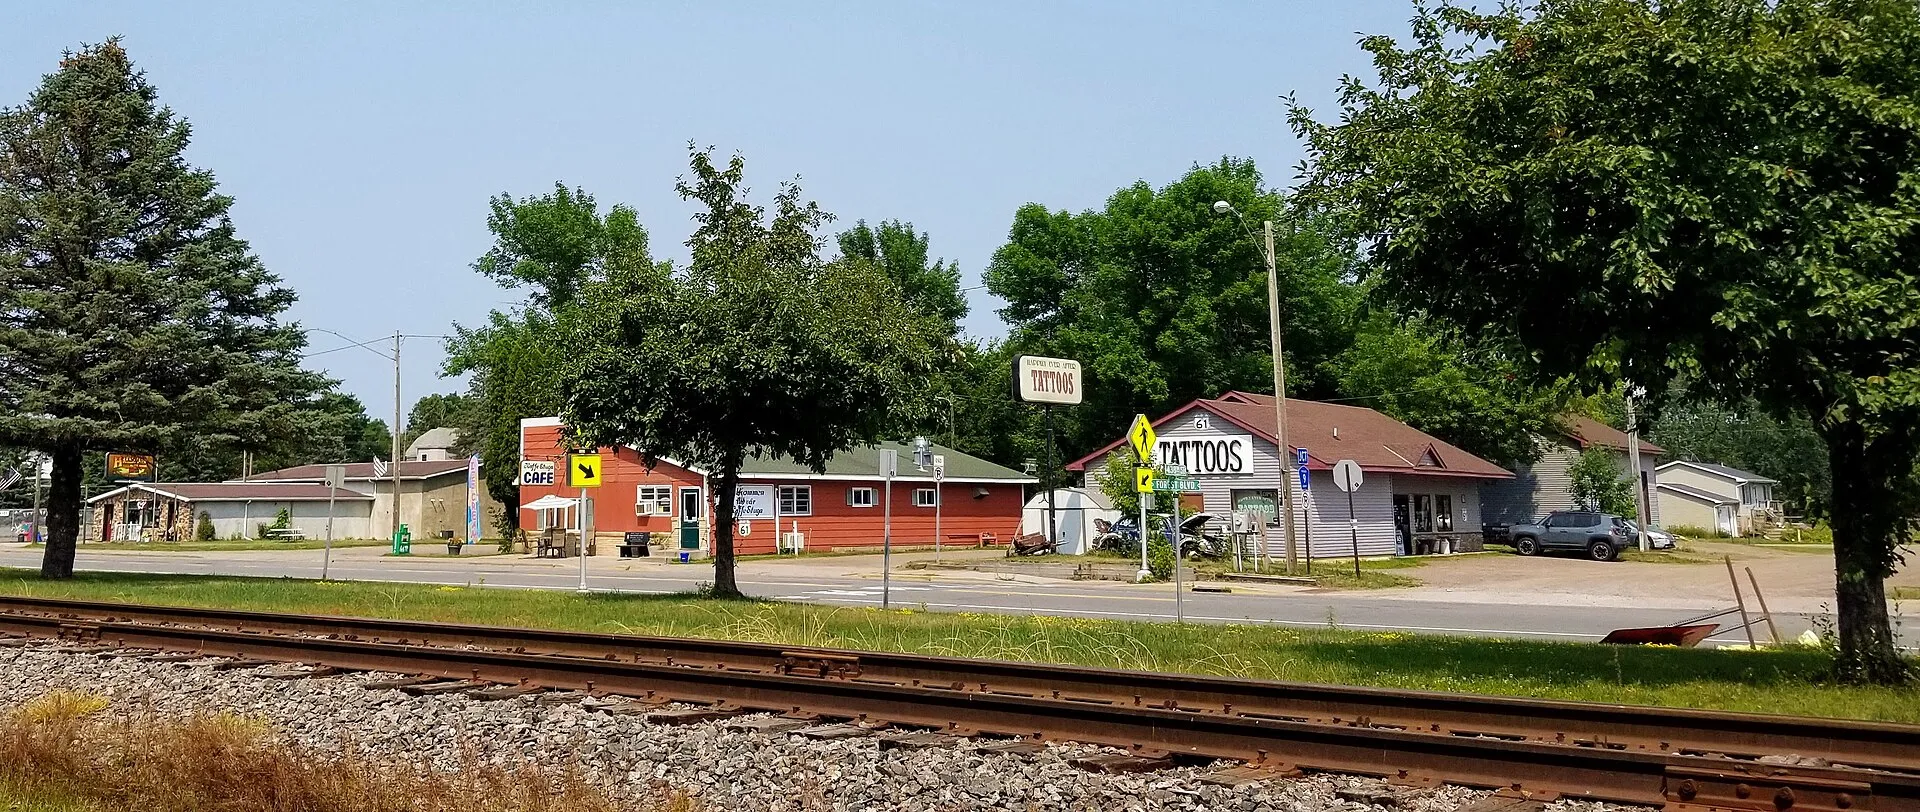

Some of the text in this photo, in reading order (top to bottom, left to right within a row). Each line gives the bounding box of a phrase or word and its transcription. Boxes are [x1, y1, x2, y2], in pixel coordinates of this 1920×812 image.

[1031, 370, 1074, 395] TATTOOS
[1196, 420, 1208, 429] 61
[1159, 440, 1243, 472] TATTOOS
[523, 472, 554, 483] CAFE
[1156, 480, 1178, 490] FOREST
[740, 526, 749, 535] 61
